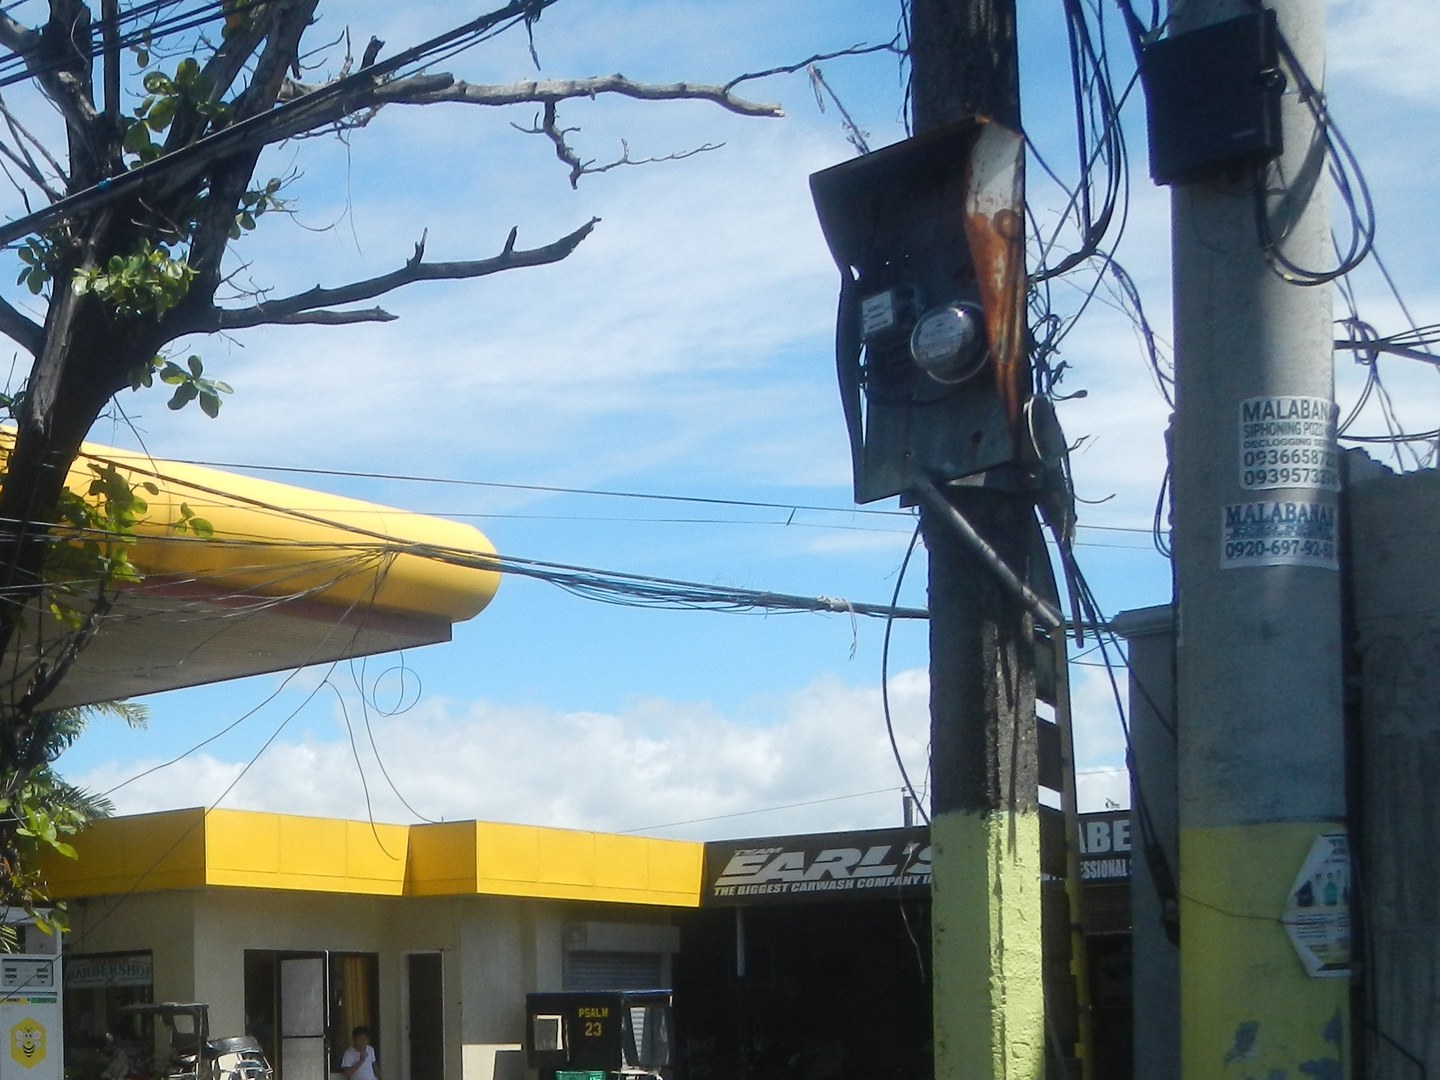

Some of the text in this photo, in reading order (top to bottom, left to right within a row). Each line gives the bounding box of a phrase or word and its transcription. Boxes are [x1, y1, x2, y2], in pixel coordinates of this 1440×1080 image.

[1078, 820, 1132, 854] BE
[714, 886, 736, 897] THE
[737, 883, 790, 896] BIGGEST
[790, 878, 855, 892] CARWASH
[856, 874, 921, 889] COMPANY
[578, 1007, 609, 1019] PSALM
[585, 1022, 602, 1037] 23
